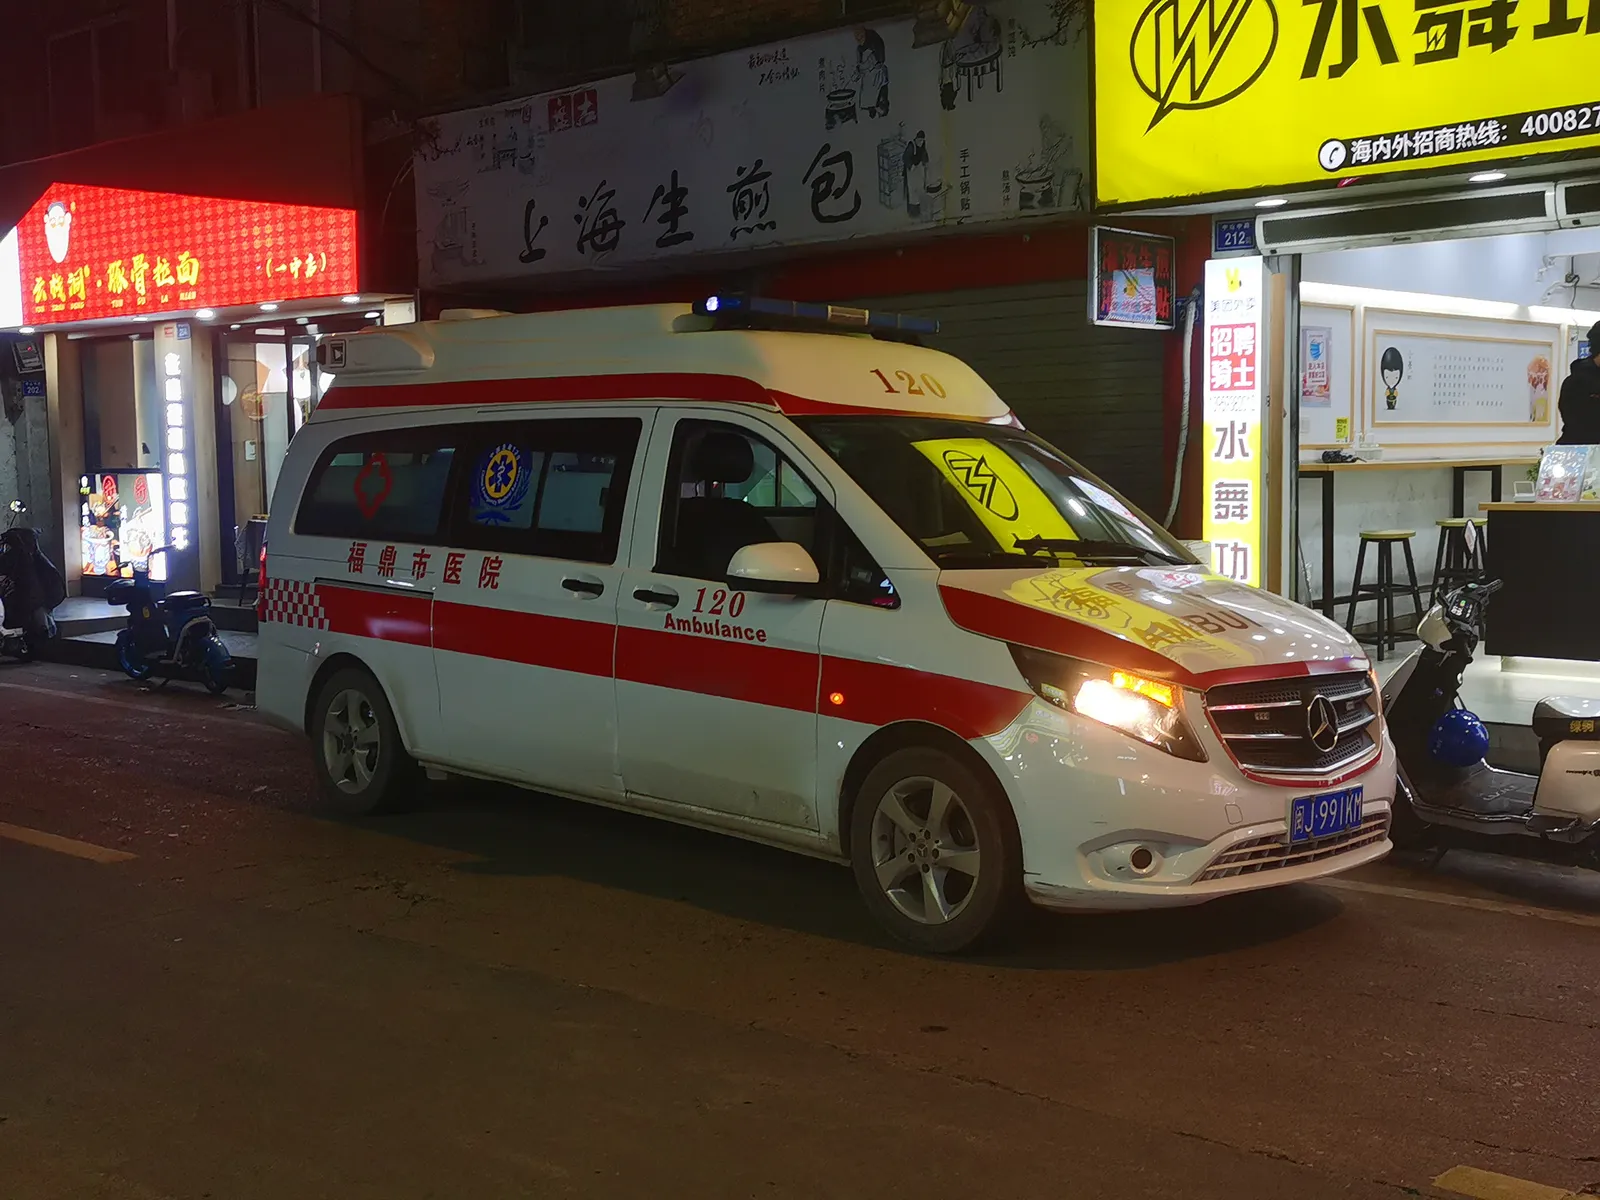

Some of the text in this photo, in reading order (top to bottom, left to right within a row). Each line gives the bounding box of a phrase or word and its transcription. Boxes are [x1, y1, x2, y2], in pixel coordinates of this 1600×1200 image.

[519, 143, 861, 264] 上海生煎包
[869, 367, 947, 399] 120
[347, 542, 503, 590] 福鼎市医院
[692, 587, 745, 618] 120
[664, 612, 767, 643] Ambulance
